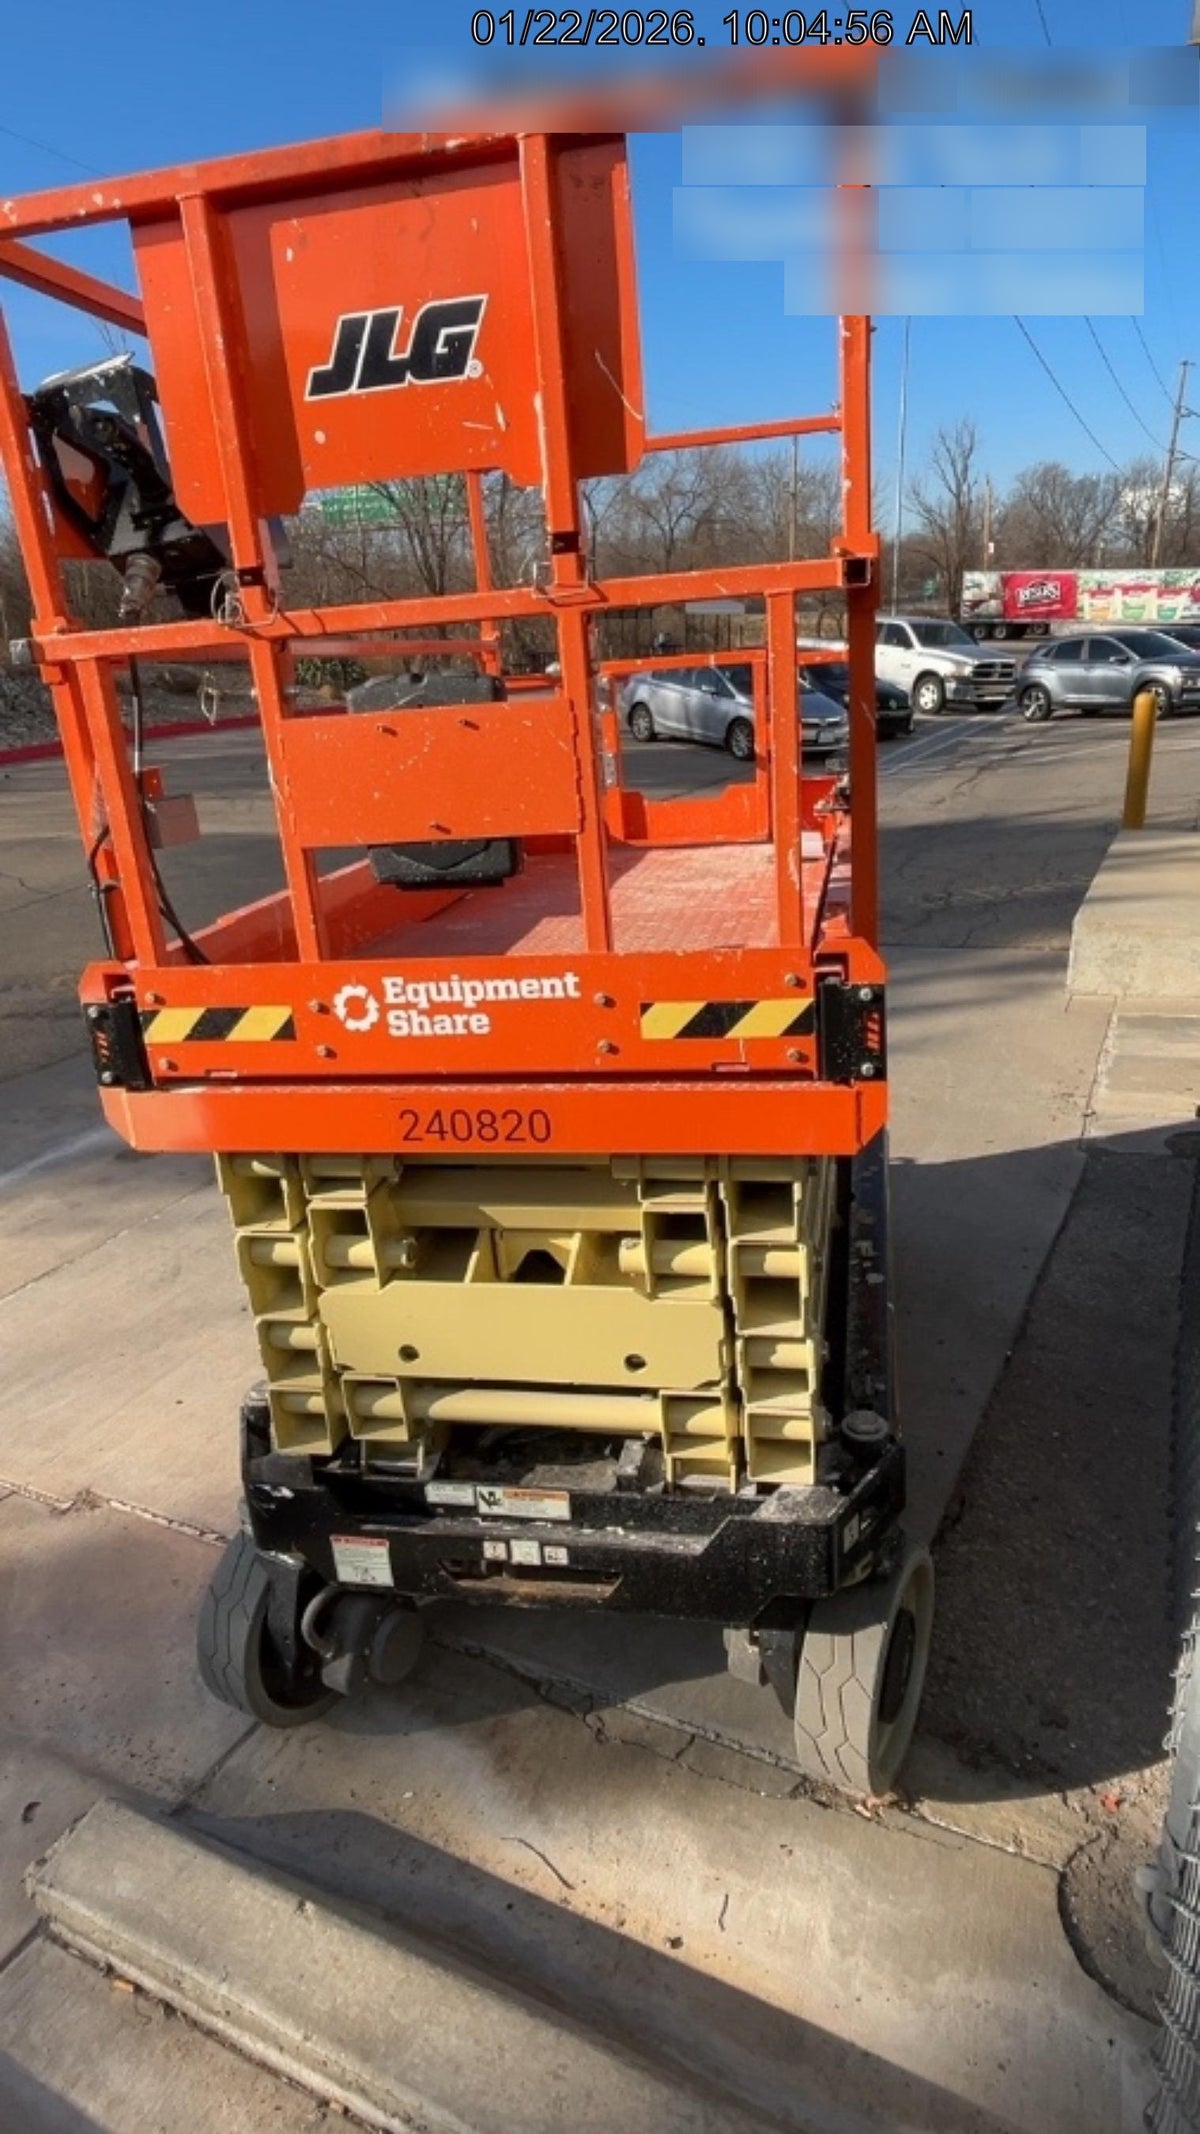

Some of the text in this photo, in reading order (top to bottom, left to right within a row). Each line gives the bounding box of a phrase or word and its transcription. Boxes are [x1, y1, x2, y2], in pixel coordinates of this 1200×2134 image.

[381, 971, 582, 1009] Equipment
[386, 1009, 491, 1037] Share
[398, 1108, 552, 1143] 240820
